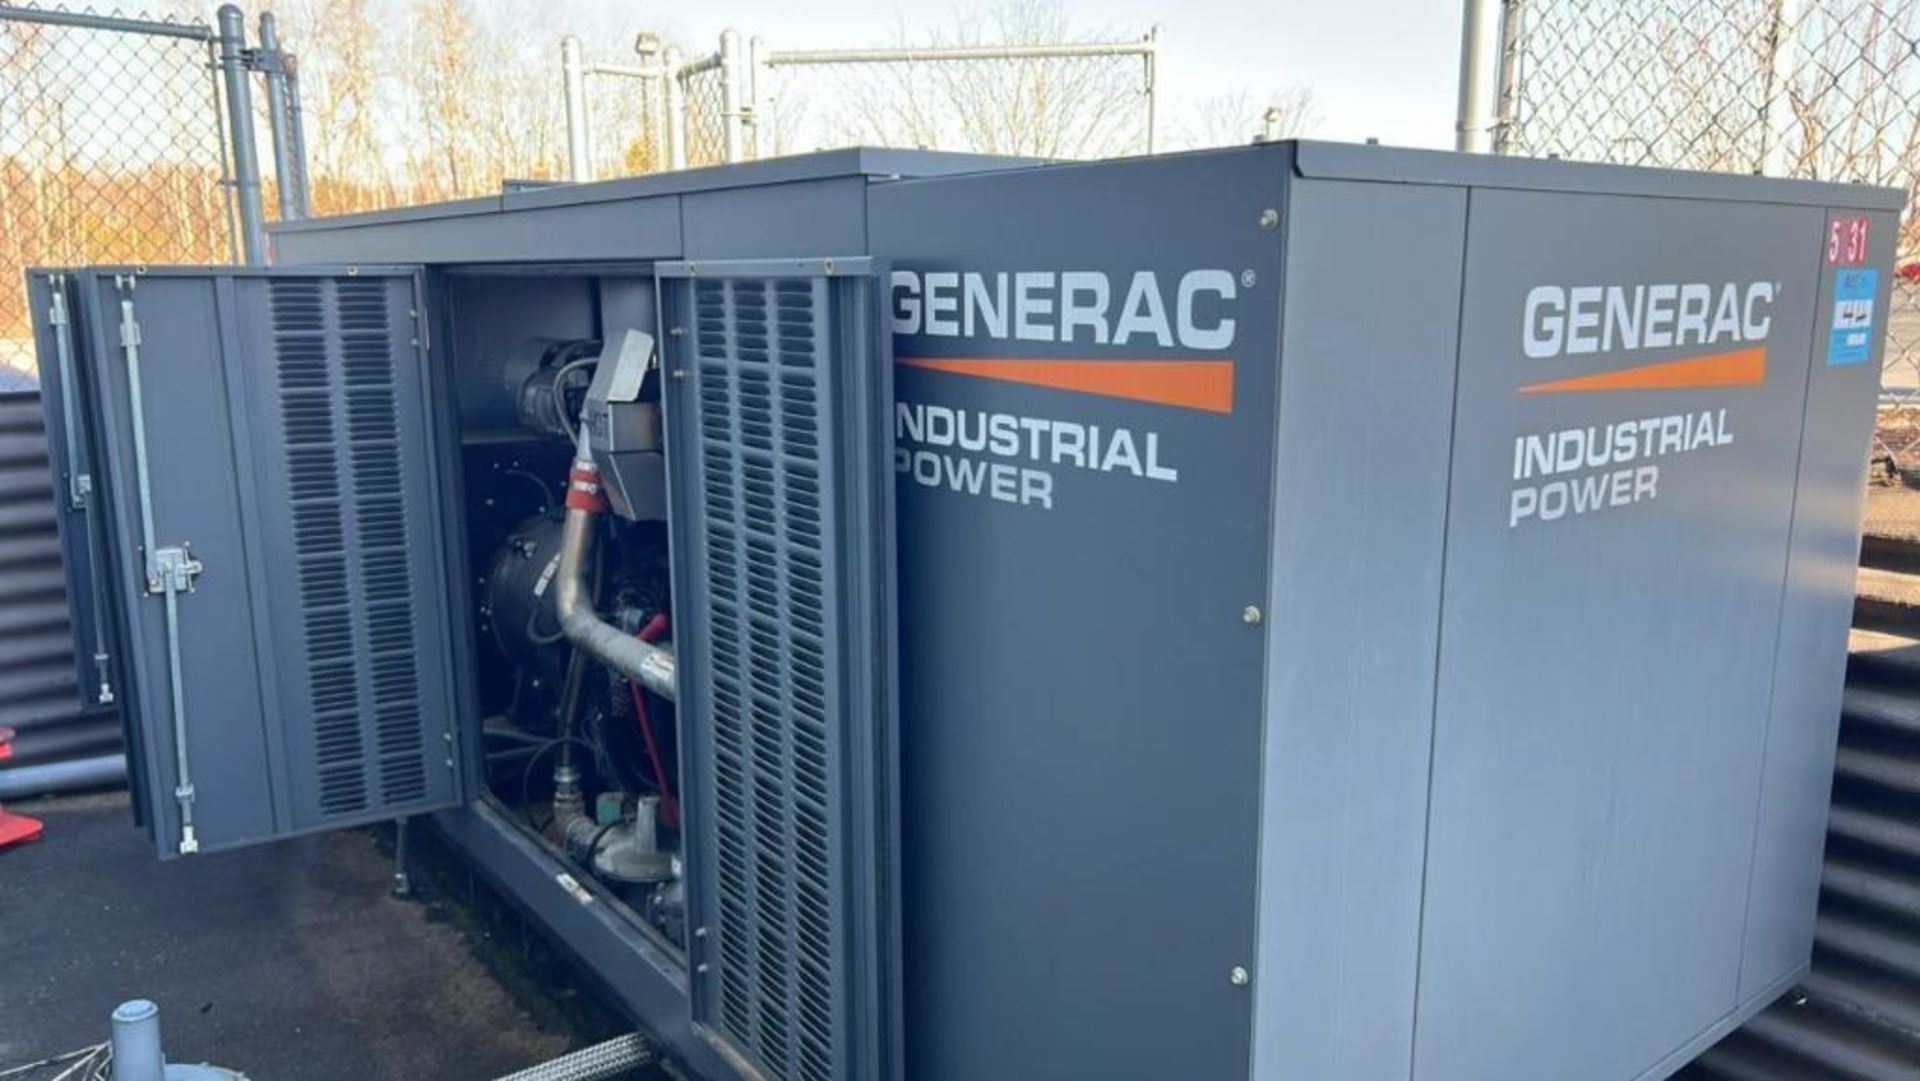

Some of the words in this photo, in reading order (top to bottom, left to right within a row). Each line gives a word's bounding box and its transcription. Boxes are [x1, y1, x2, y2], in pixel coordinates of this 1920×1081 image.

[1523, 281, 1774, 358] GENERAC
[896, 402, 1178, 482] NDUSTRIAL
[1513, 408, 1735, 480] INDUSTRIAL
[1509, 465, 1659, 527] POWER
